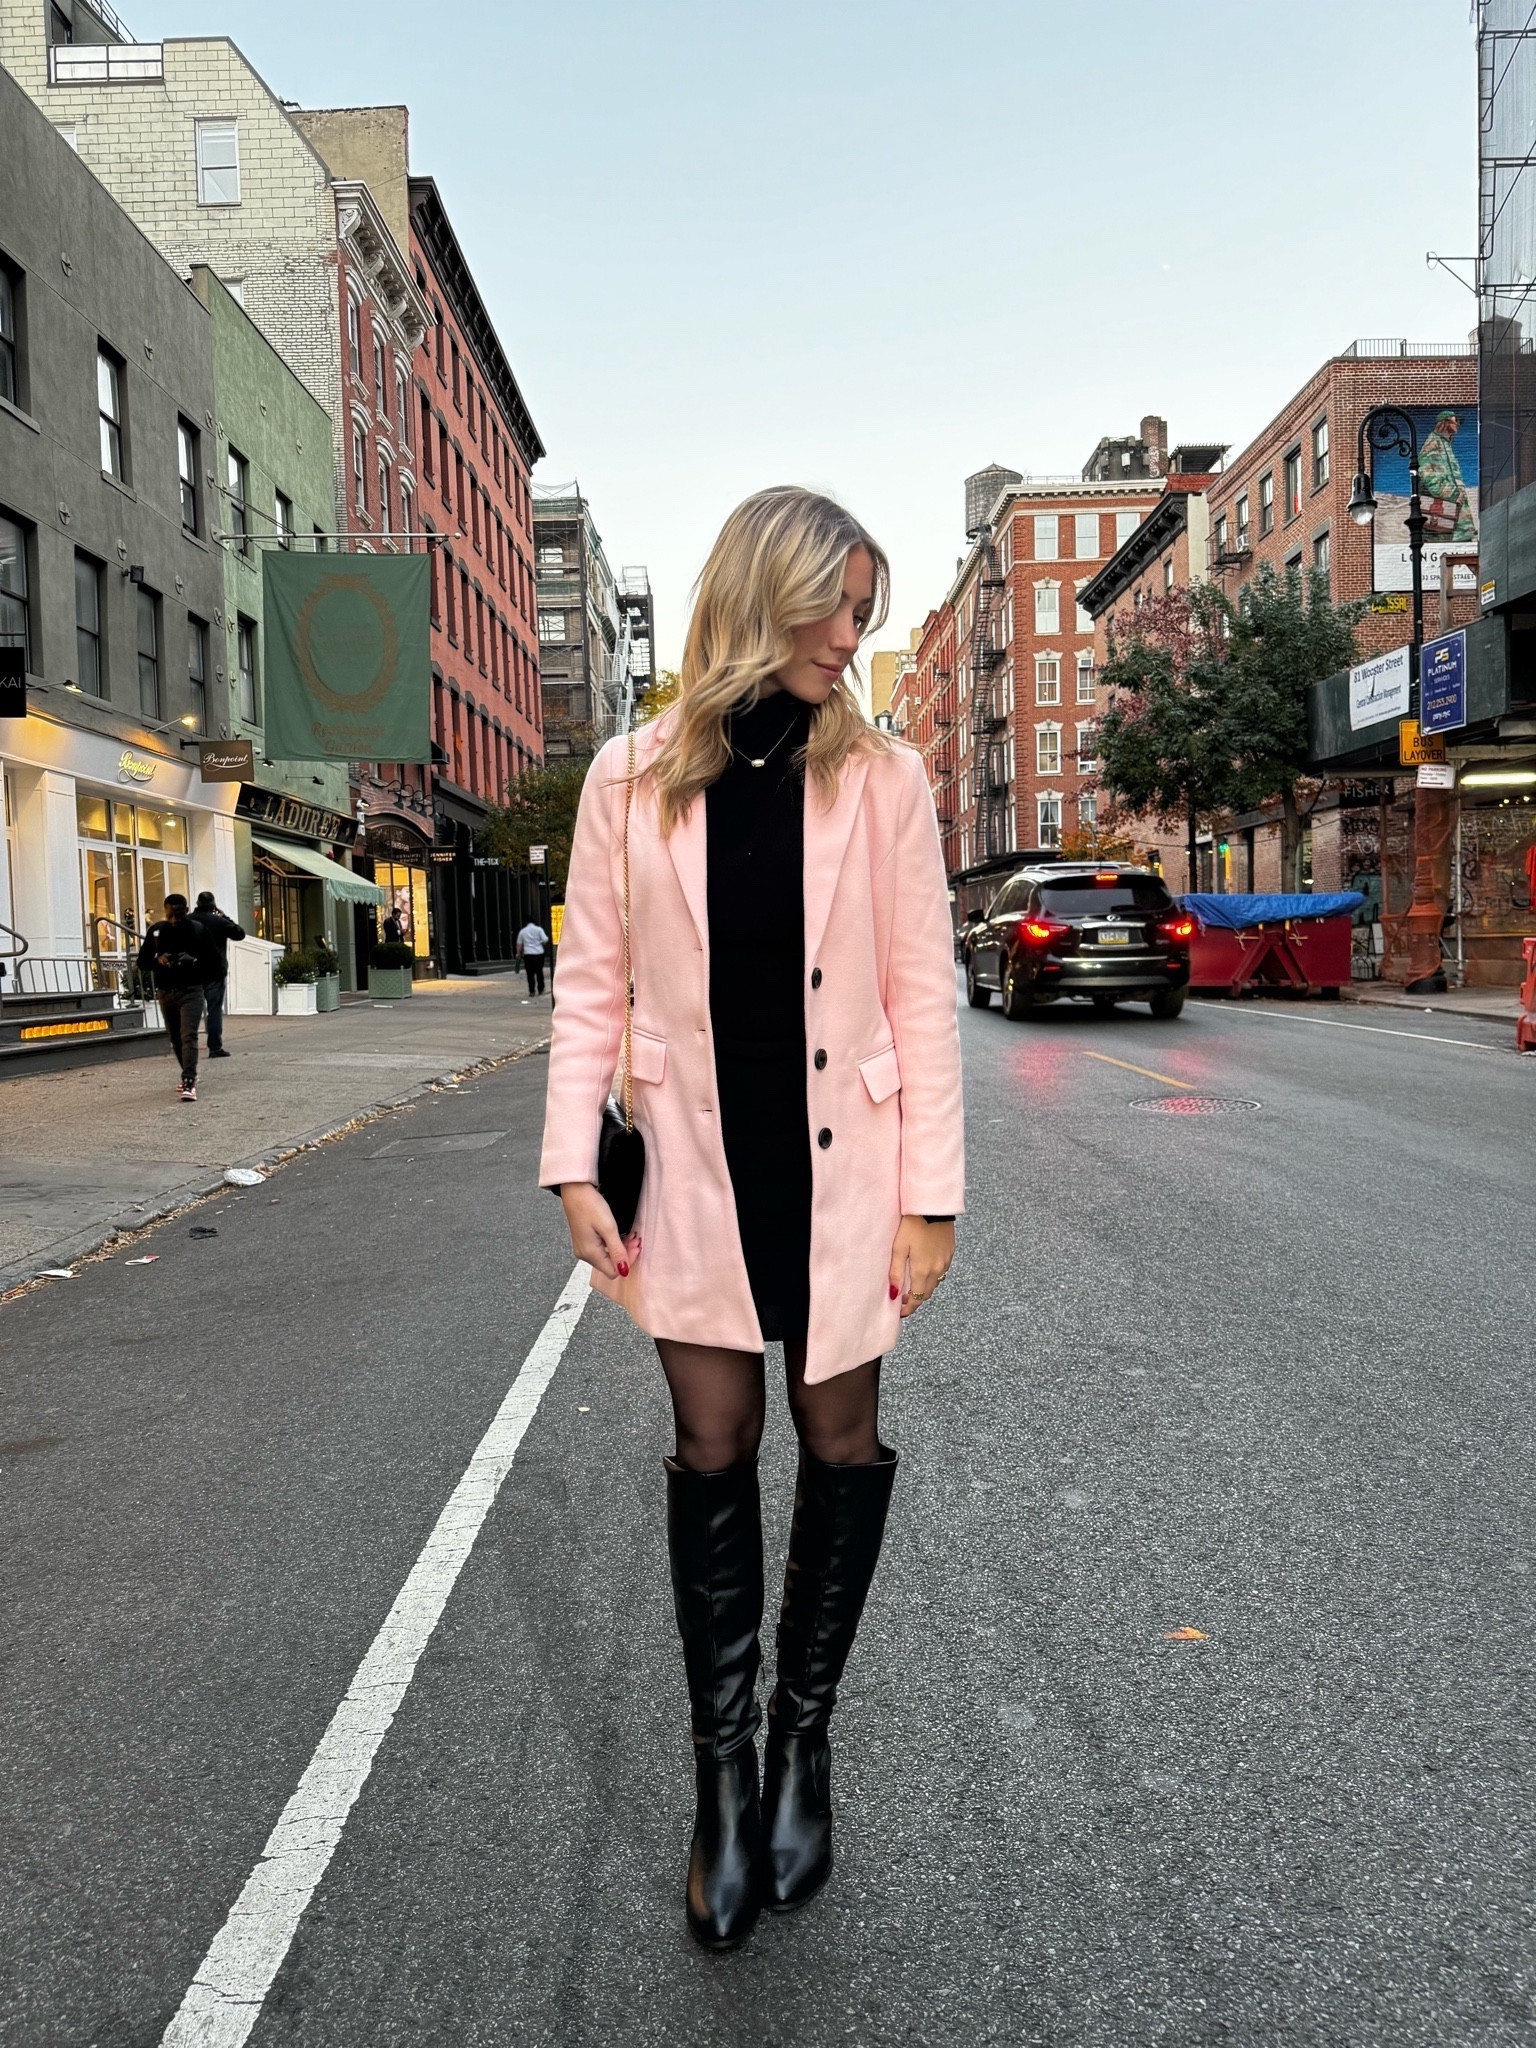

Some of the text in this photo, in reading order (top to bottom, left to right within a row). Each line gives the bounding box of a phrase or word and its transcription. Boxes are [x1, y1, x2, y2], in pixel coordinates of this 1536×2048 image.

[1353, 655, 1404, 684] 81 Wooster Street
[1427, 660, 1458, 678] PLATINUM
[1413, 736, 1434, 748] BUS
[202, 752, 249, 771] Bonpoint
[1404, 749, 1443, 761] LAYOVER
[118, 751, 156, 780] Bonpoint
